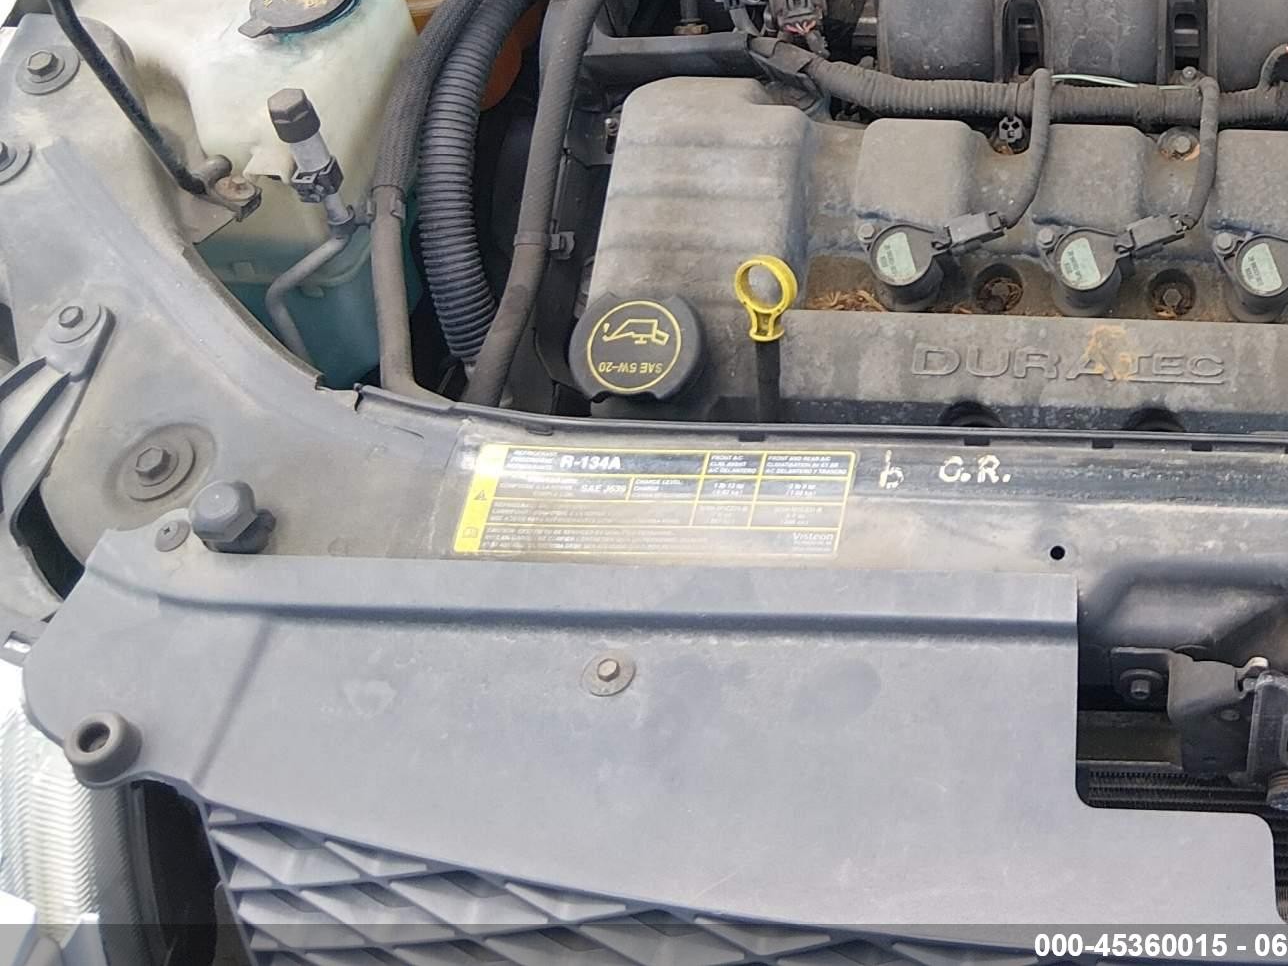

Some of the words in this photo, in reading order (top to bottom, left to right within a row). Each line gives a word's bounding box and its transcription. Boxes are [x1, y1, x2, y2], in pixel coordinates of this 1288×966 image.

[598, 362, 637, 374] 5W-20
[640, 362, 664, 374] SAE
[911, 343, 1225, 382] DURATEC
[560, 455, 622, 470] R-134A
[793, 532, 834, 541] Visteon
